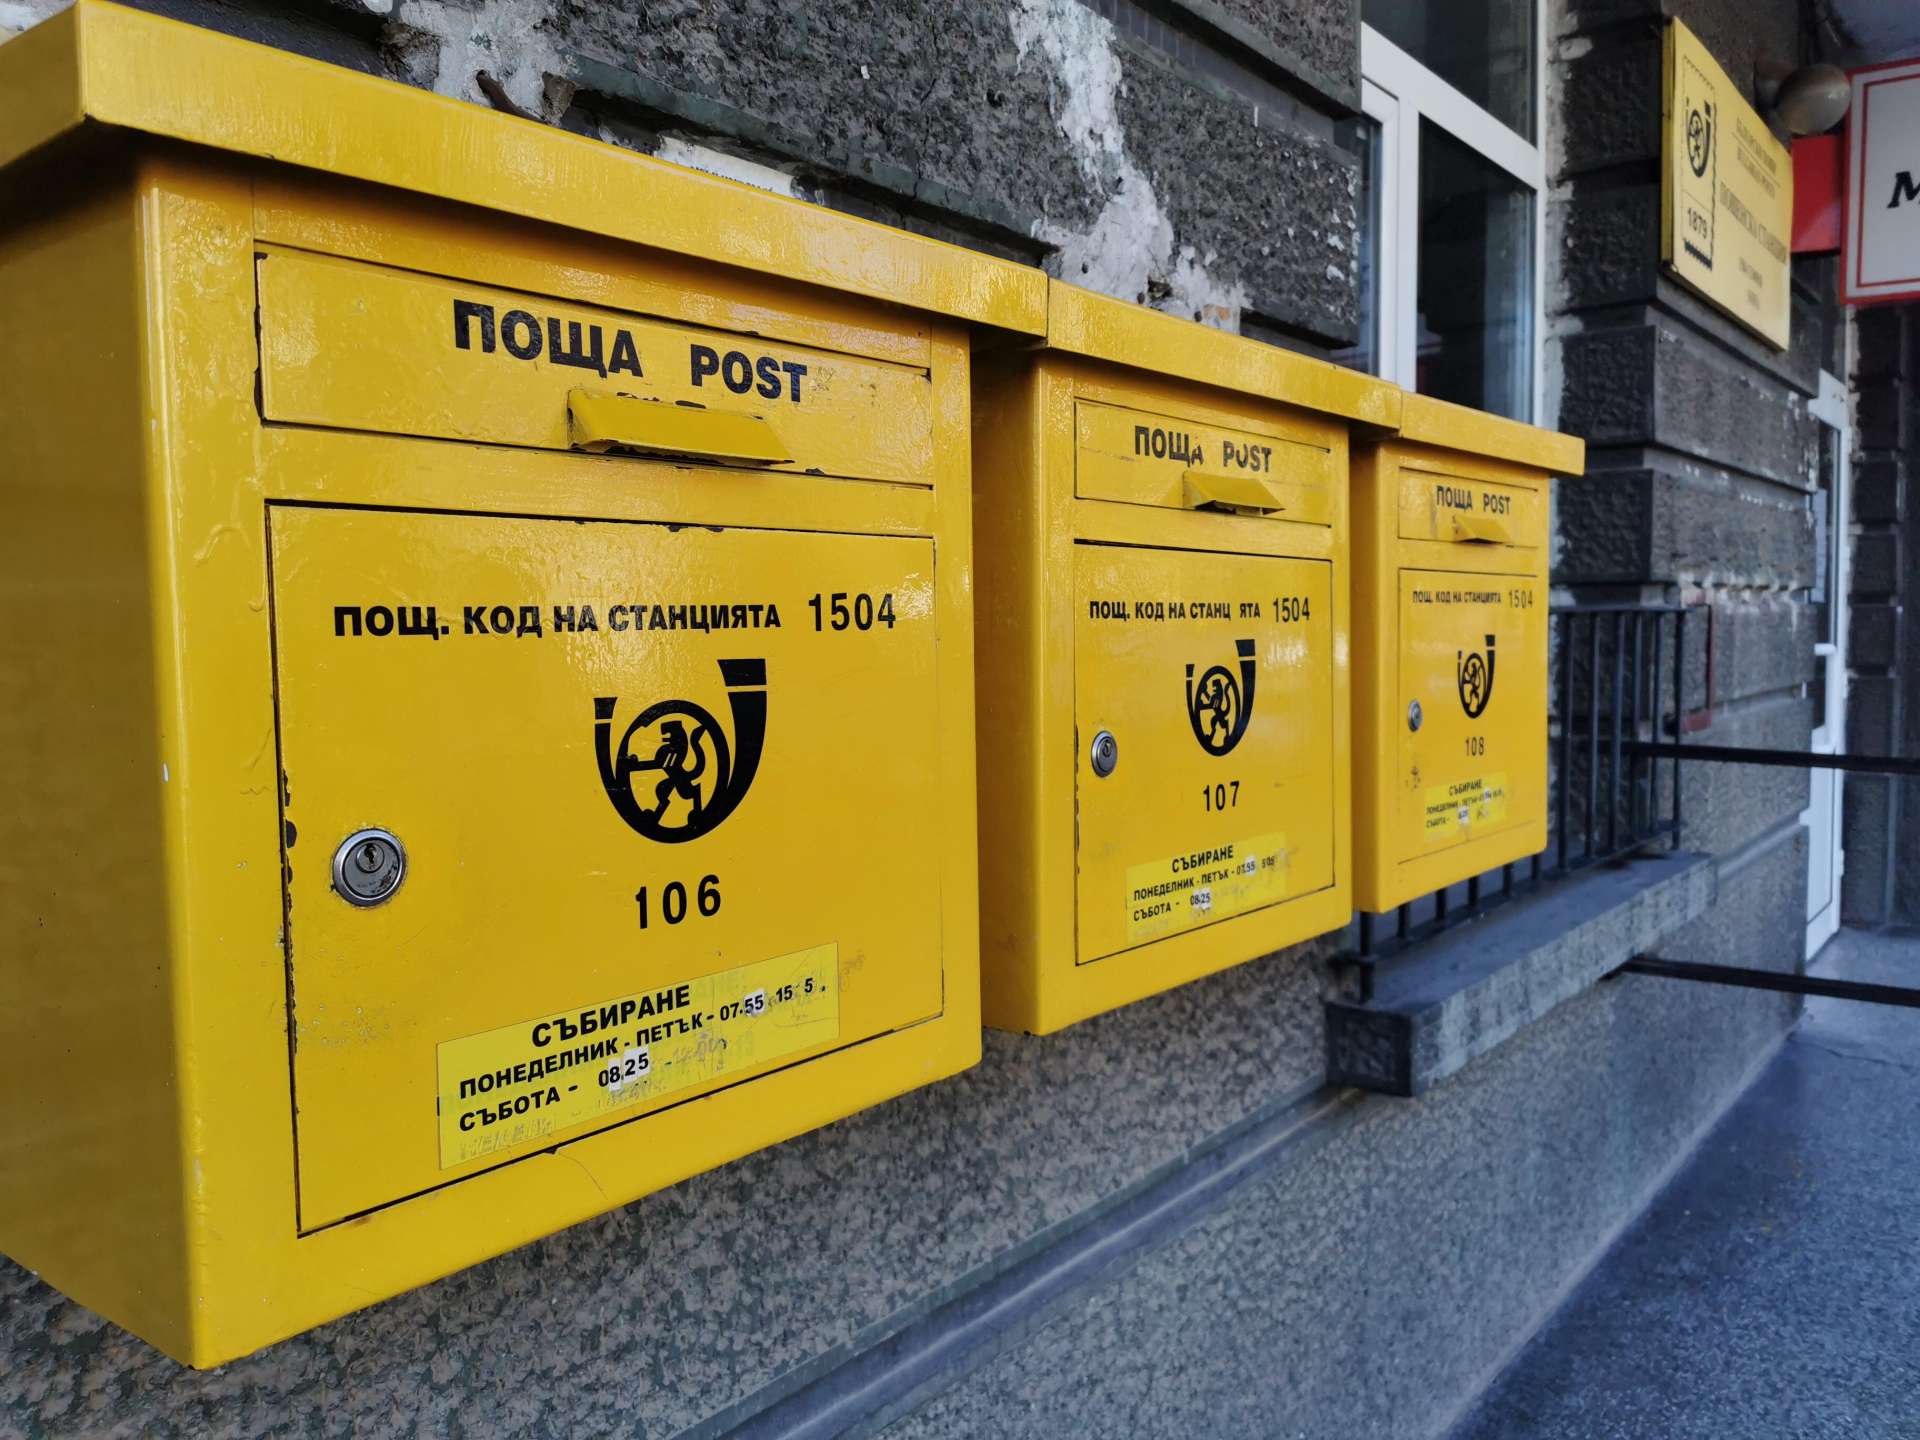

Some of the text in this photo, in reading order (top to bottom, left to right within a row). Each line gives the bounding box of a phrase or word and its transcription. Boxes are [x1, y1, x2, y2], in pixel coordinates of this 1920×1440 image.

[1686, 207, 1708, 241] 1879
[453, 298, 809, 403] ПОЩА POST
[1134, 424, 1272, 473] ПОЩА POST
[1436, 485, 1511, 515] ПОЩА POST
[1089, 600, 1131, 623] ПОЩ.
[1136, 601, 1165, 622] КОД
[1168, 602, 1186, 619] НА
[1273, 597, 1310, 623] 1504
[1413, 589, 1533, 609] ПОЩ. КОД НА СТАНЦИЯТА 1504
[333, 593, 897, 641] ПОЩ. КОД НА СТАНЦИЯТА 1504
[1465, 736, 1485, 756] 108
[1203, 780, 1240, 812] 107
[1449, 779, 1482, 796] СЪБИРАНЕ
[1426, 817, 1446, 828] СЪБОТА
[1172, 845, 1234, 873] СЪБИРАНЕ
[1133, 877, 1195, 901] ПОНЕДЕЛНИК
[1201, 869, 1229, 885] ПЕТЪК
[635, 874, 722, 930] 106
[1133, 902, 1171, 921] СЪБОТА
[532, 984, 690, 1048] СЪБИРАНЕ
[459, 1041, 619, 1100] ПОНЕДЕЛНИК
[636, 1012, 703, 1047] ПЕТЪК
[459, 1085, 561, 1132] СЪБОТА
